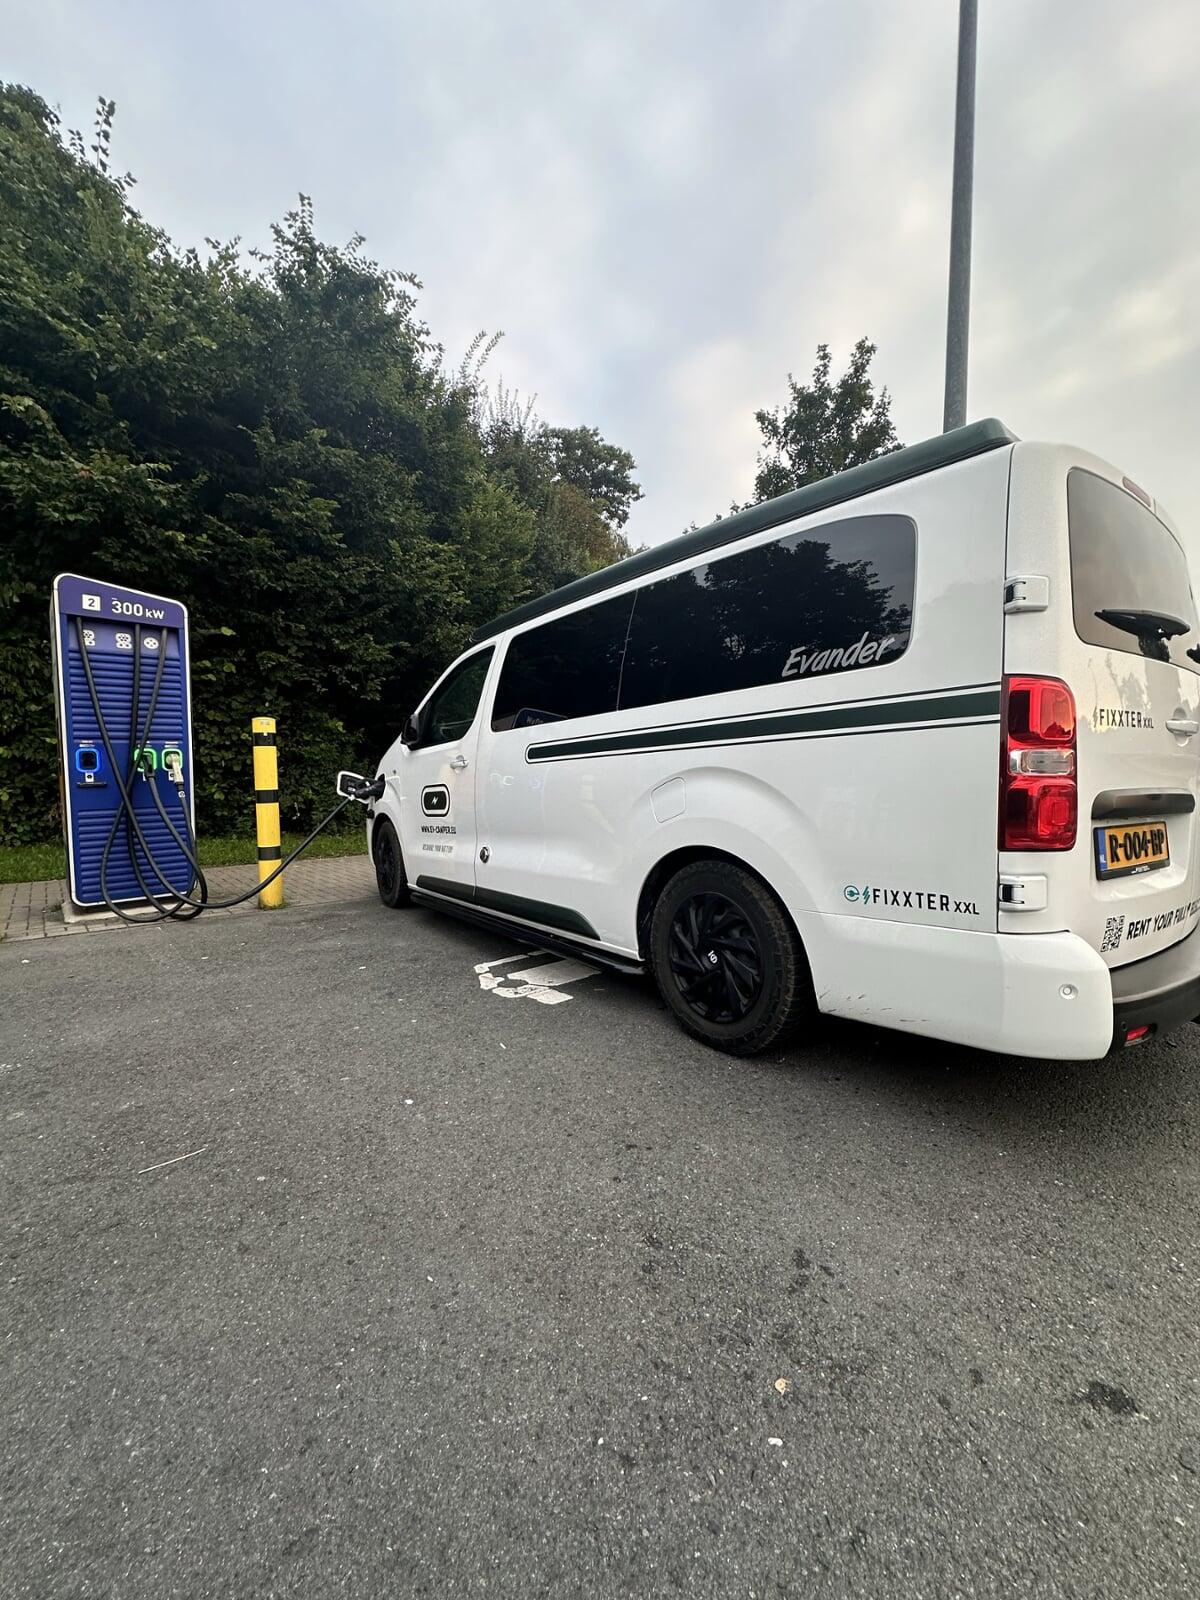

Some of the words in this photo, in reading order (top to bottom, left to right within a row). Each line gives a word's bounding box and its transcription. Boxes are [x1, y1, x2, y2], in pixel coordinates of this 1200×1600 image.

[88, 598, 95, 607] 2
[111, 599, 143, 616] 300
[145, 608, 165, 619] kW
[781, 631, 895, 677] Evander
[1099, 709, 1142, 728] FIXXTER
[873, 888, 950, 911] FIXXTER
[953, 901, 980, 915] XXL
[1126, 918, 1152, 940] RENT
[1153, 910, 1174, 932] YOUR
